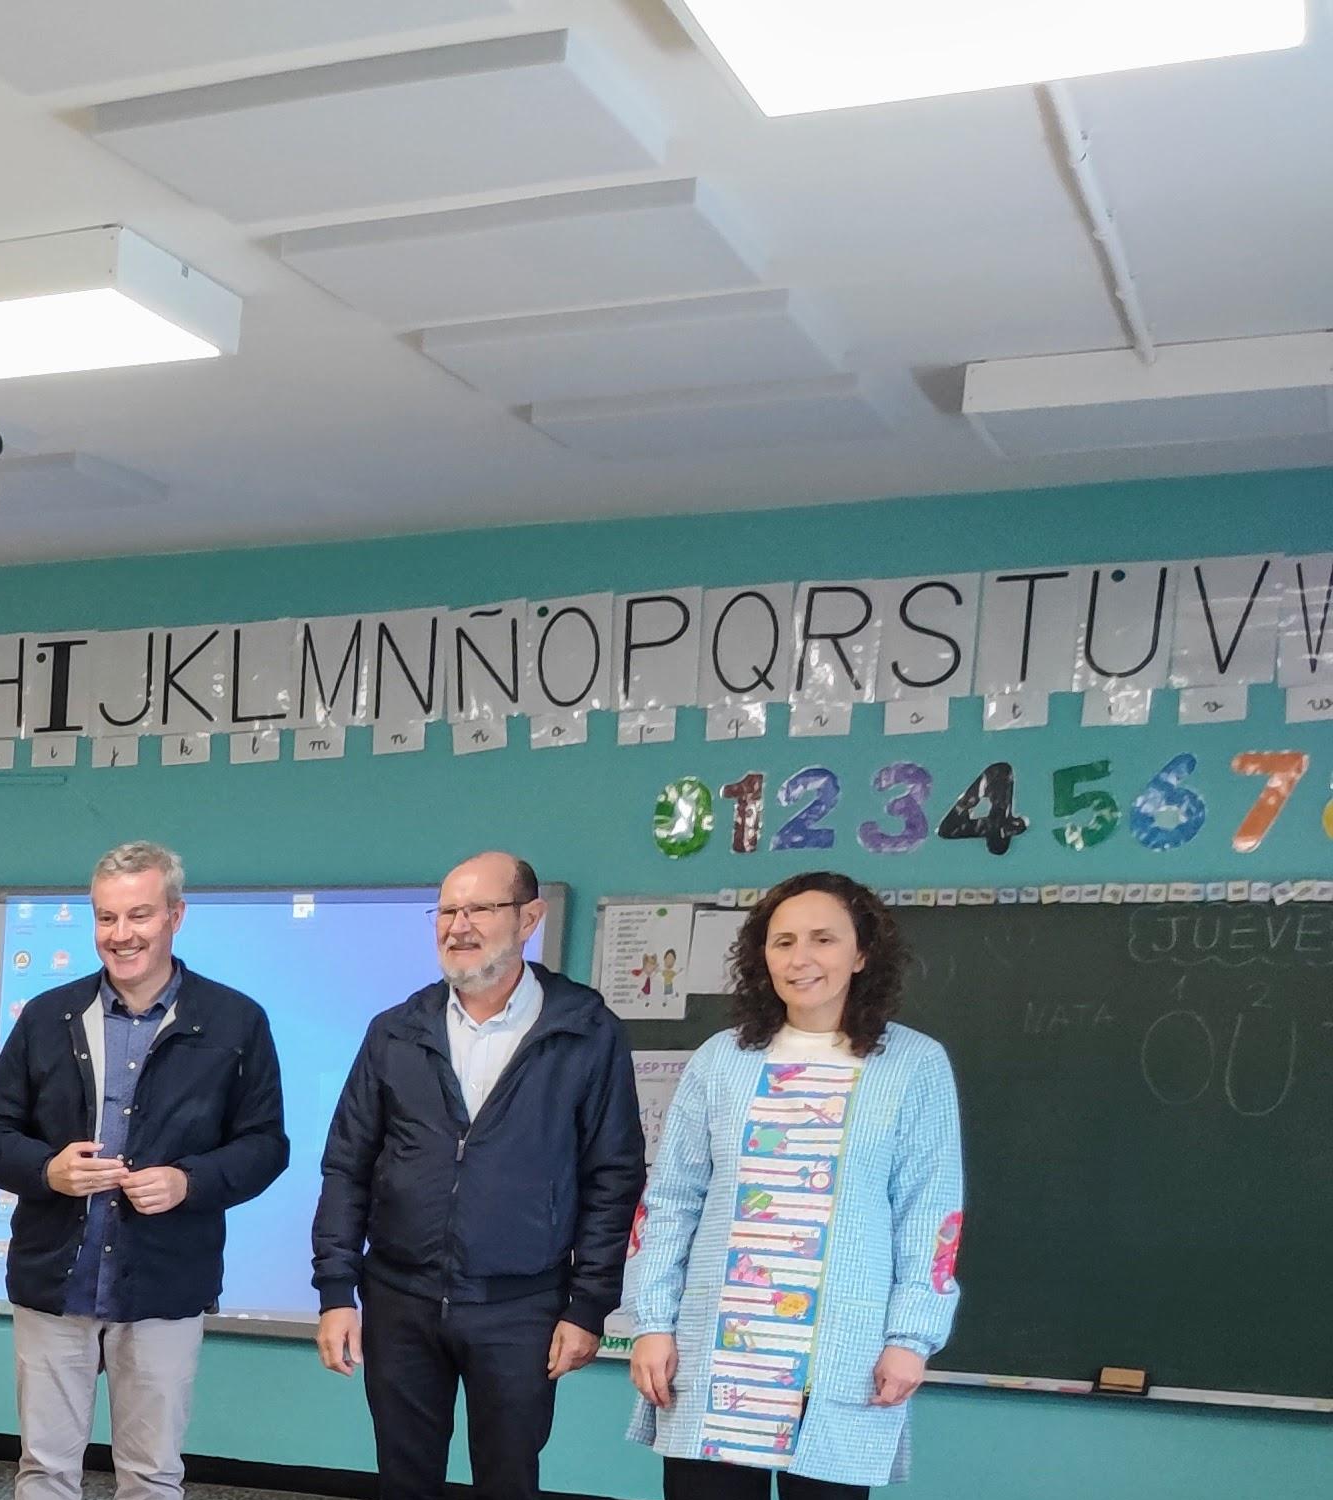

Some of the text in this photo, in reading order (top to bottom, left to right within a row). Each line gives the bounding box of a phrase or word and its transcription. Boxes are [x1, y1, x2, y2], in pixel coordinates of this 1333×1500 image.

[33, 639, 88, 734] I
[98, 632, 154, 727] J
[161, 629, 220, 726] K
[232, 628, 287, 723] L
[299, 618, 362, 720] M
[374, 616, 438, 720] N
[455, 607, 519, 713] Ñ
[537, 606, 601, 708] O
[623, 595, 691, 701] P
[712, 590, 780, 694] Q
[796, 585, 873, 692] R
[890, 580, 964, 689] S
[995, 570, 1070, 683] T
[1084, 566, 1169, 678] U
[1193, 560, 1271, 675] V
[654, 750, 1310, 861] 0 1 2 3 4 5 6 7
[1151, 912, 1333, 952] JUEVE
